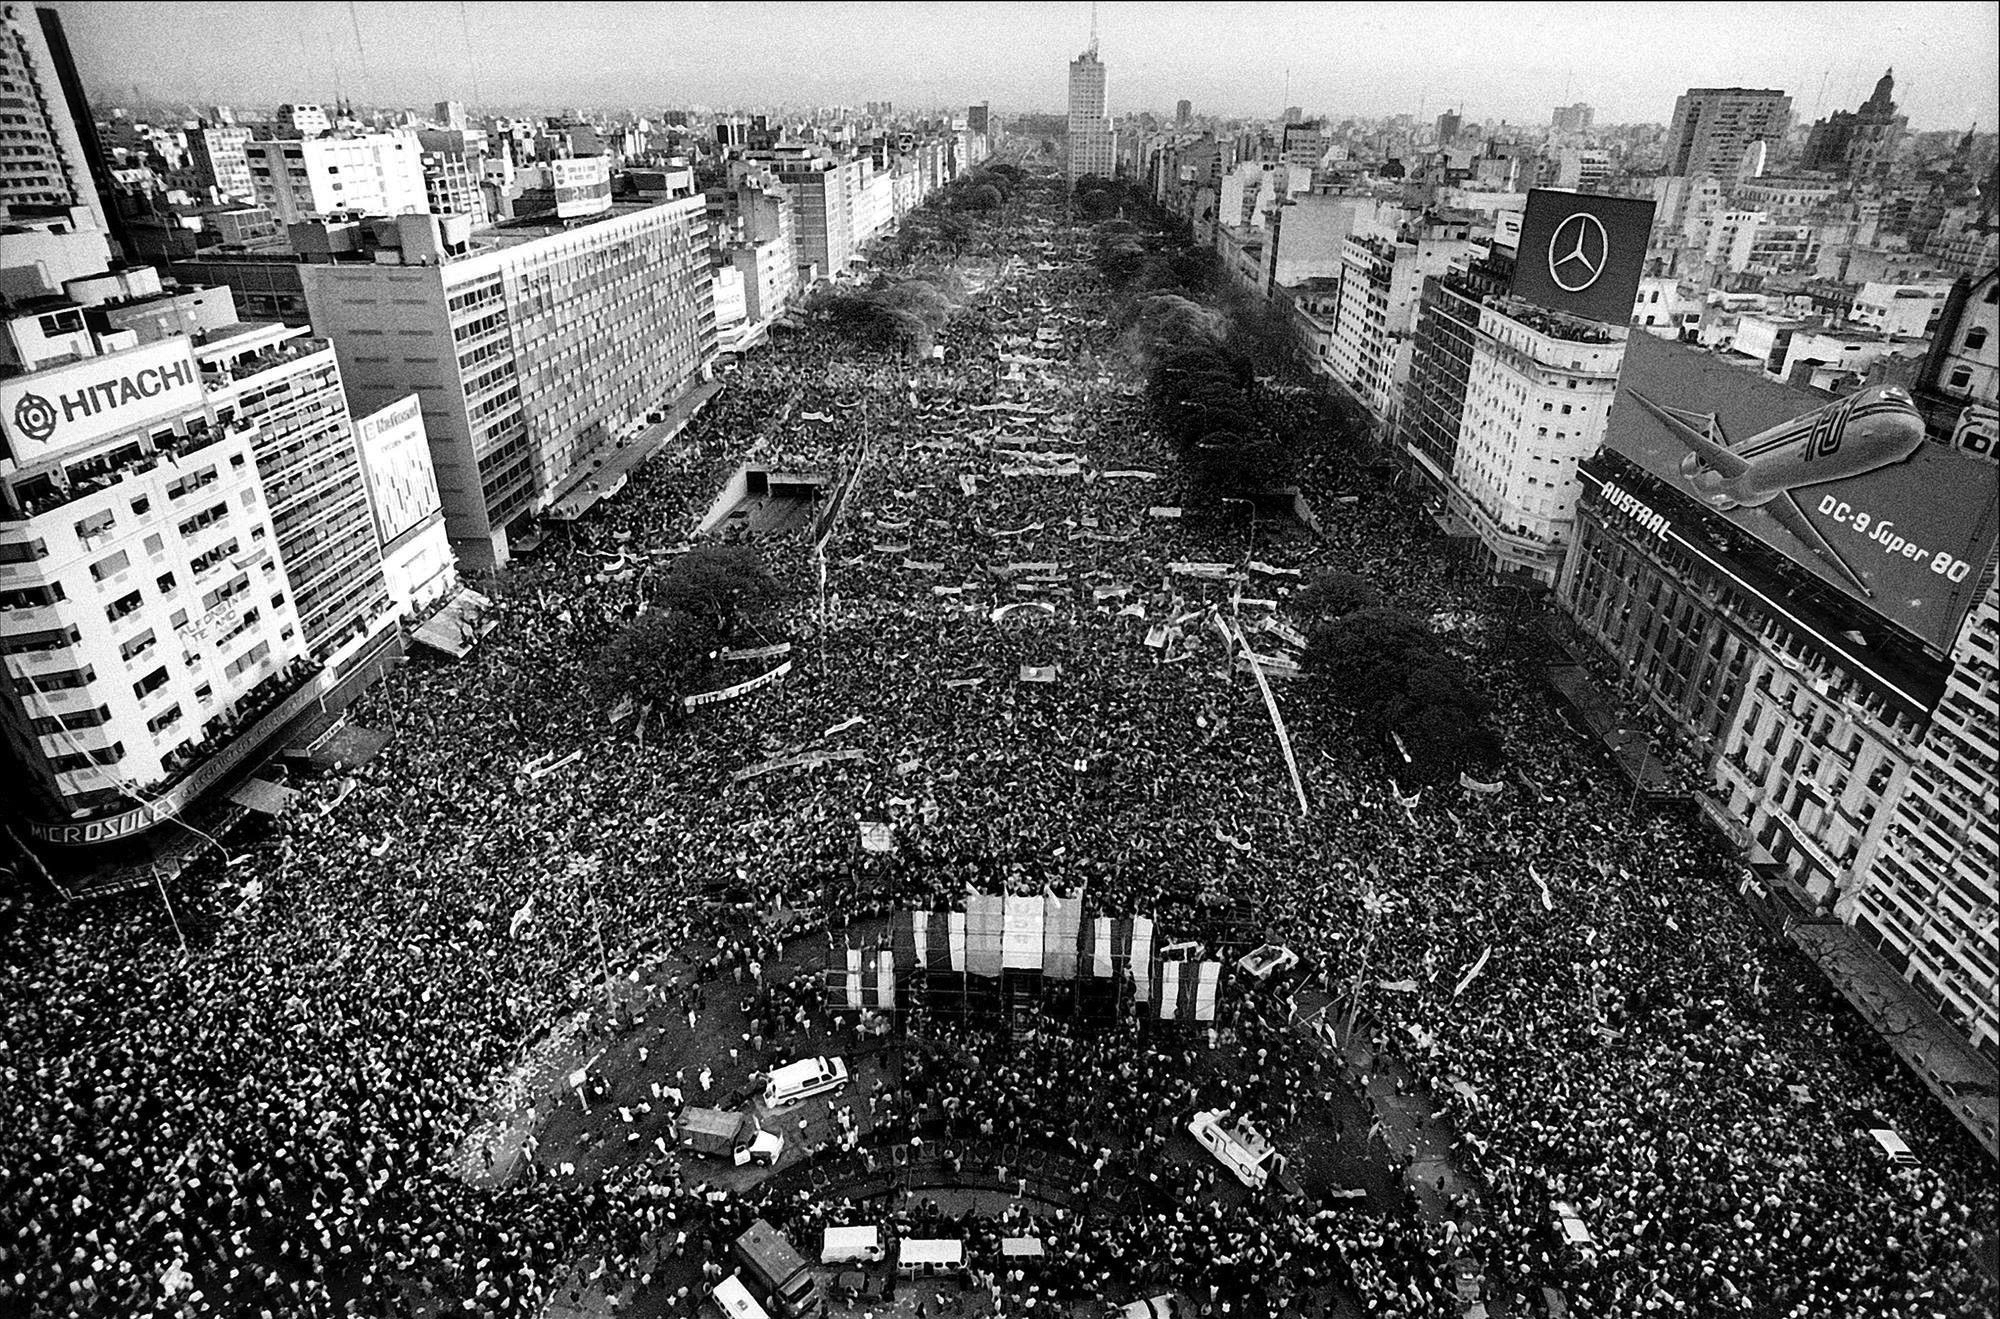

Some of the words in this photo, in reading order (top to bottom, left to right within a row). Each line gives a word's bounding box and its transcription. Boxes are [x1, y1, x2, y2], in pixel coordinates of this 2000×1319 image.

[60, 359, 193, 422] HITACHI
[1601, 481, 1671, 542] AUSTRAL
[1818, 494, 1871, 533] DC-9
[1868, 520, 1929, 562] Super
[1930, 551, 1971, 583] 80
[192, 627, 209, 641] TE
